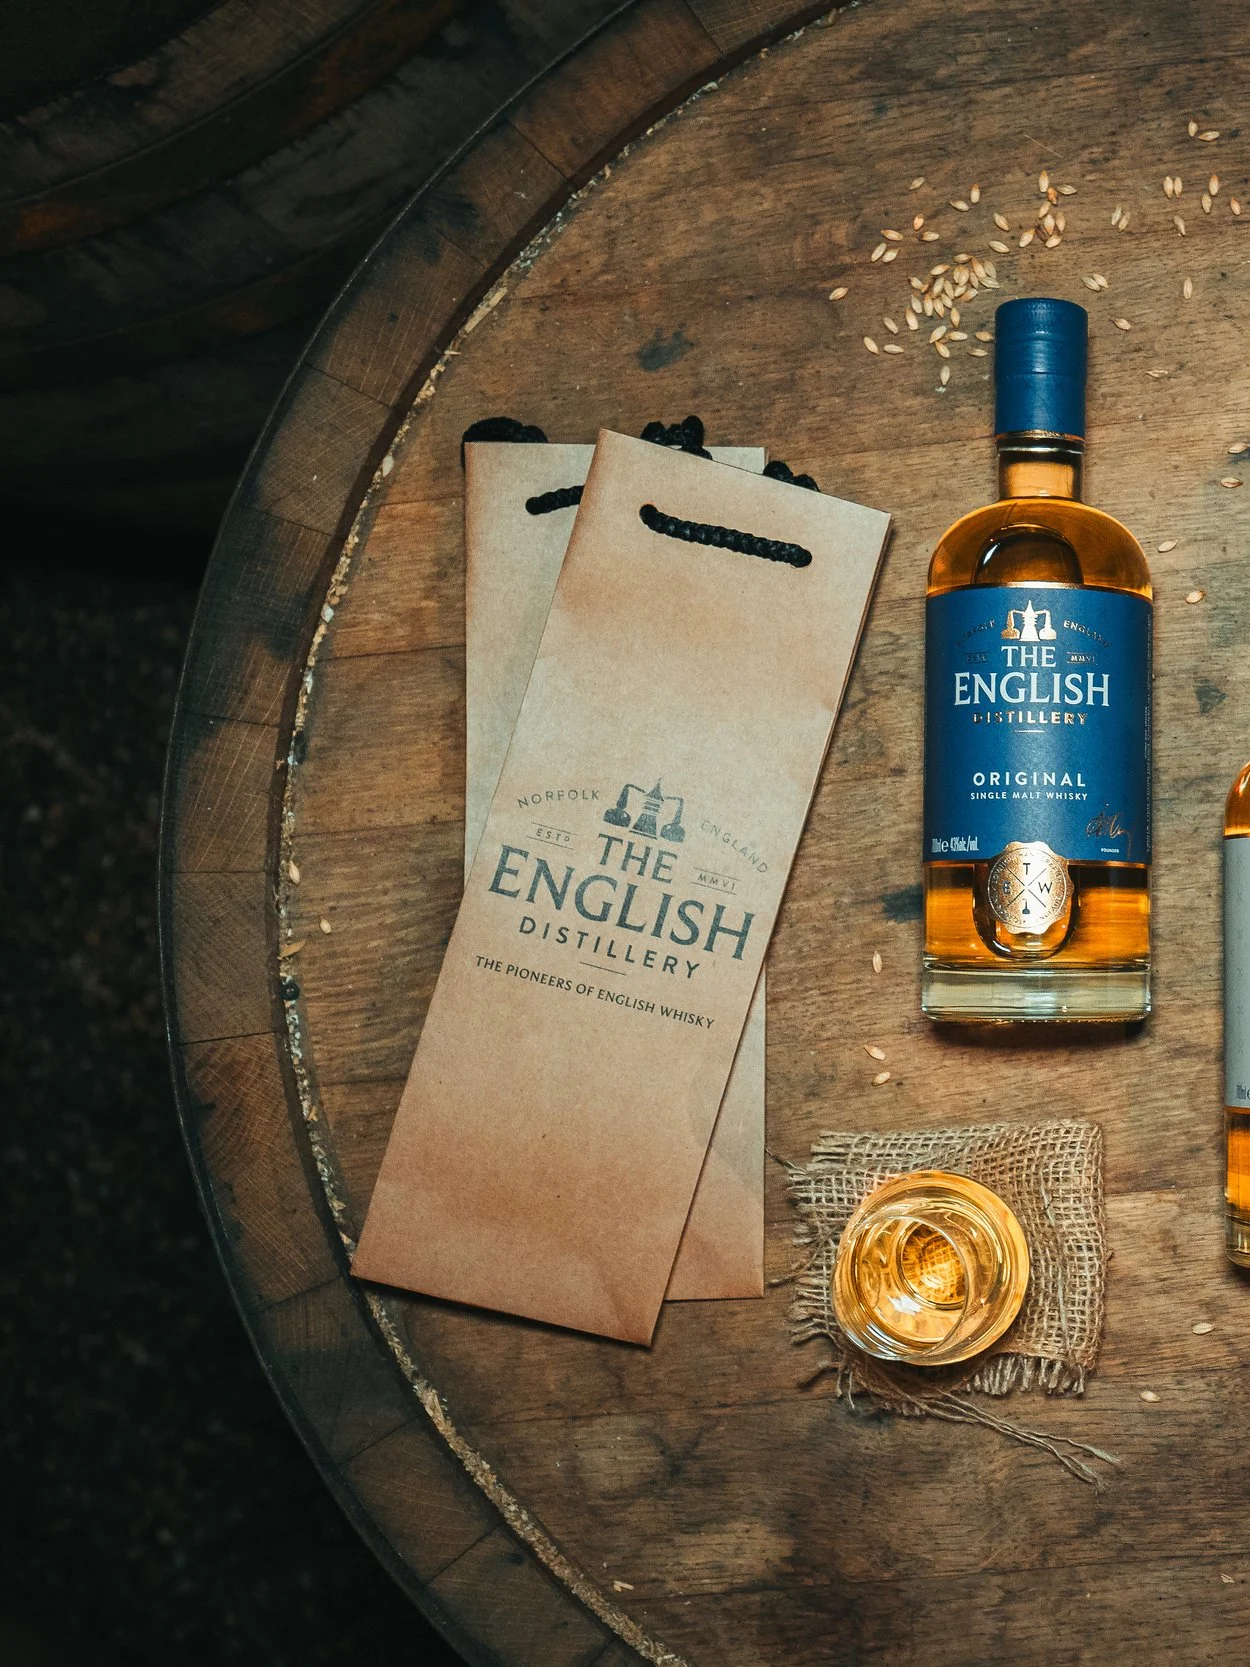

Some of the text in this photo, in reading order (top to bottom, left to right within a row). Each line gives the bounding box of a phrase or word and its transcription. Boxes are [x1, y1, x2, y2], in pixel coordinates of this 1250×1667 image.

[1000, 646, 1057, 667] THE
[954, 672, 1110, 707] ENGLISH
[973, 711, 1089, 725] DISTILLERY
[973, 772, 1086, 787] ORIGINAL
[517, 789, 600, 809] NORFOLK
[970, 791, 1088, 801] SINGLE MALT WHISKY
[701, 819, 769, 874] ENGLAND
[597, 833, 678, 885] THE
[1022, 862, 1031, 875] T
[697, 872, 737, 891] MMVI
[1038, 881, 1053, 894] W
[488, 844, 755, 961] ENGLISH
[519, 915, 700, 979] DISTILLERY
[476, 955, 715, 1030] THE PIONEERS OF ENGLISH WHISKY
